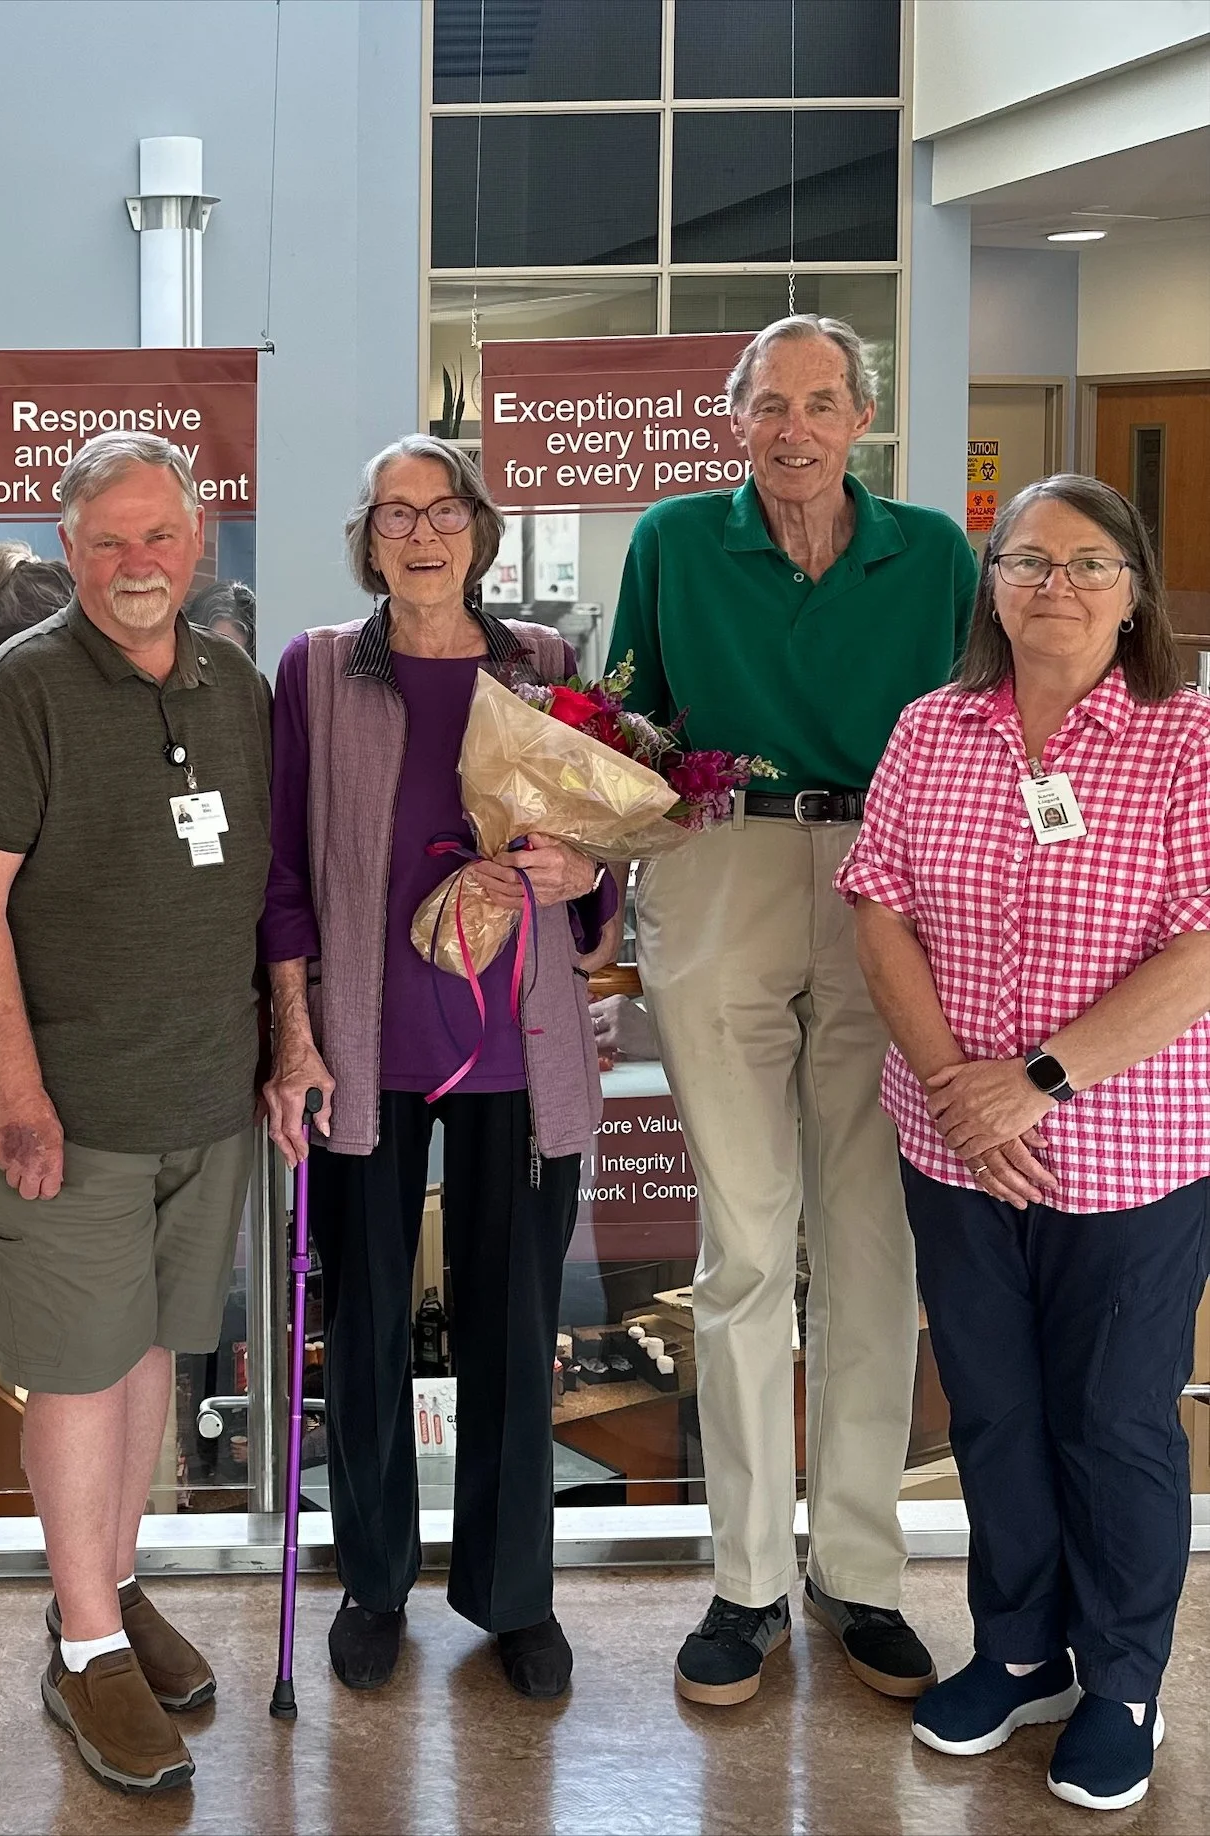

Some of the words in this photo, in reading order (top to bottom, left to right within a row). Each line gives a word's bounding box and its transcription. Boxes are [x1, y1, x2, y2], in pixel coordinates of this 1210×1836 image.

[13, 400, 202, 438] Responsive
[493, 389, 683, 428] Exceptional
[693, 393, 731, 417] ca
[14, 438, 73, 468] and
[546, 430, 635, 460] every
[643, 423, 720, 453] time,
[968, 442, 997, 455] AUTION
[504, 459, 548, 488] for
[556, 462, 644, 492] every
[637, 1115, 683, 1133] Valu
[602, 1152, 676, 1175] Integrity
[577, 1183, 626, 1202] work
[642, 1182, 698, 1203] Comp
